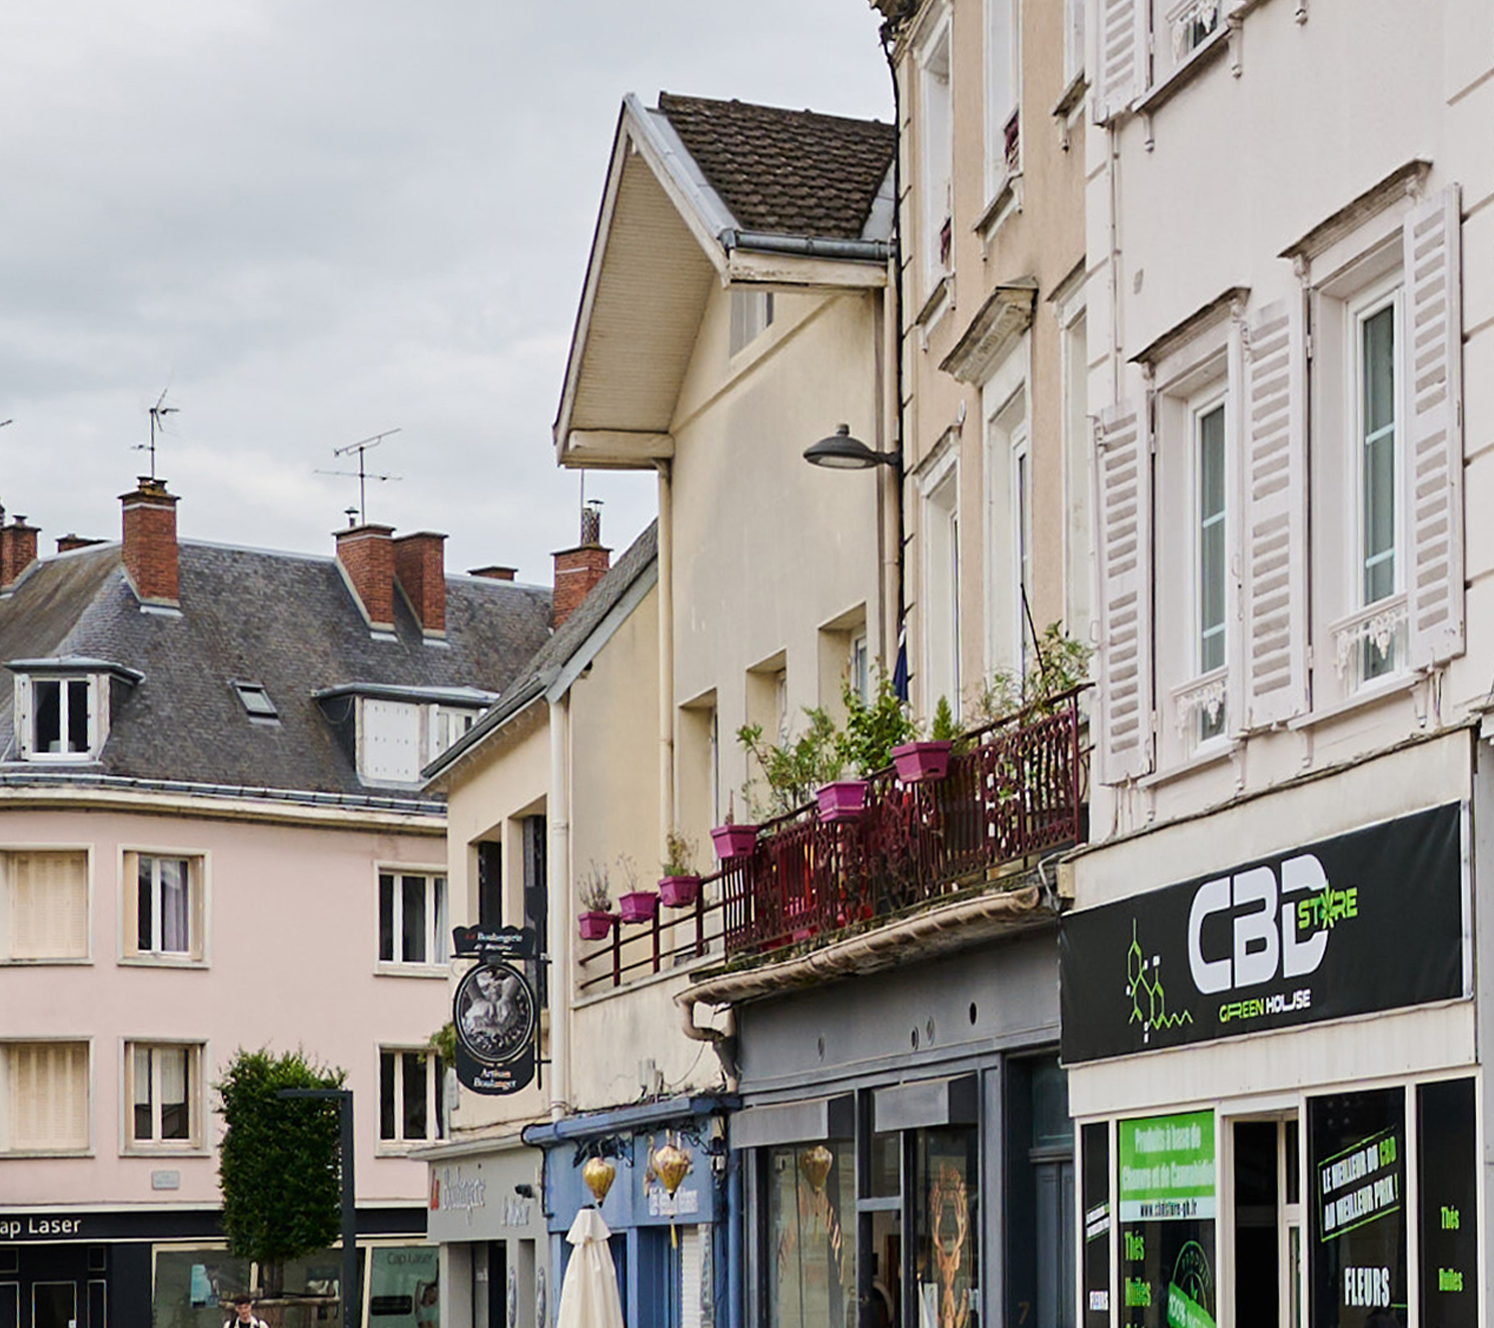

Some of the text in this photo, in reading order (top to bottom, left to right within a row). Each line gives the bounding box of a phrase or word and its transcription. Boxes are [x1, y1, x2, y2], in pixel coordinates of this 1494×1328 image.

[1188, 854, 1328, 994] CBD
[1219, 989, 1311, 1023] GREEN HOUSE
[28, 1217, 81, 1234] Laser
[1441, 1205, 1459, 1230] Thés
[1124, 1229, 1145, 1261] Thés
[1344, 1266, 1391, 1308] FLEURS
[1018, 1301, 1030, 1325] 7
